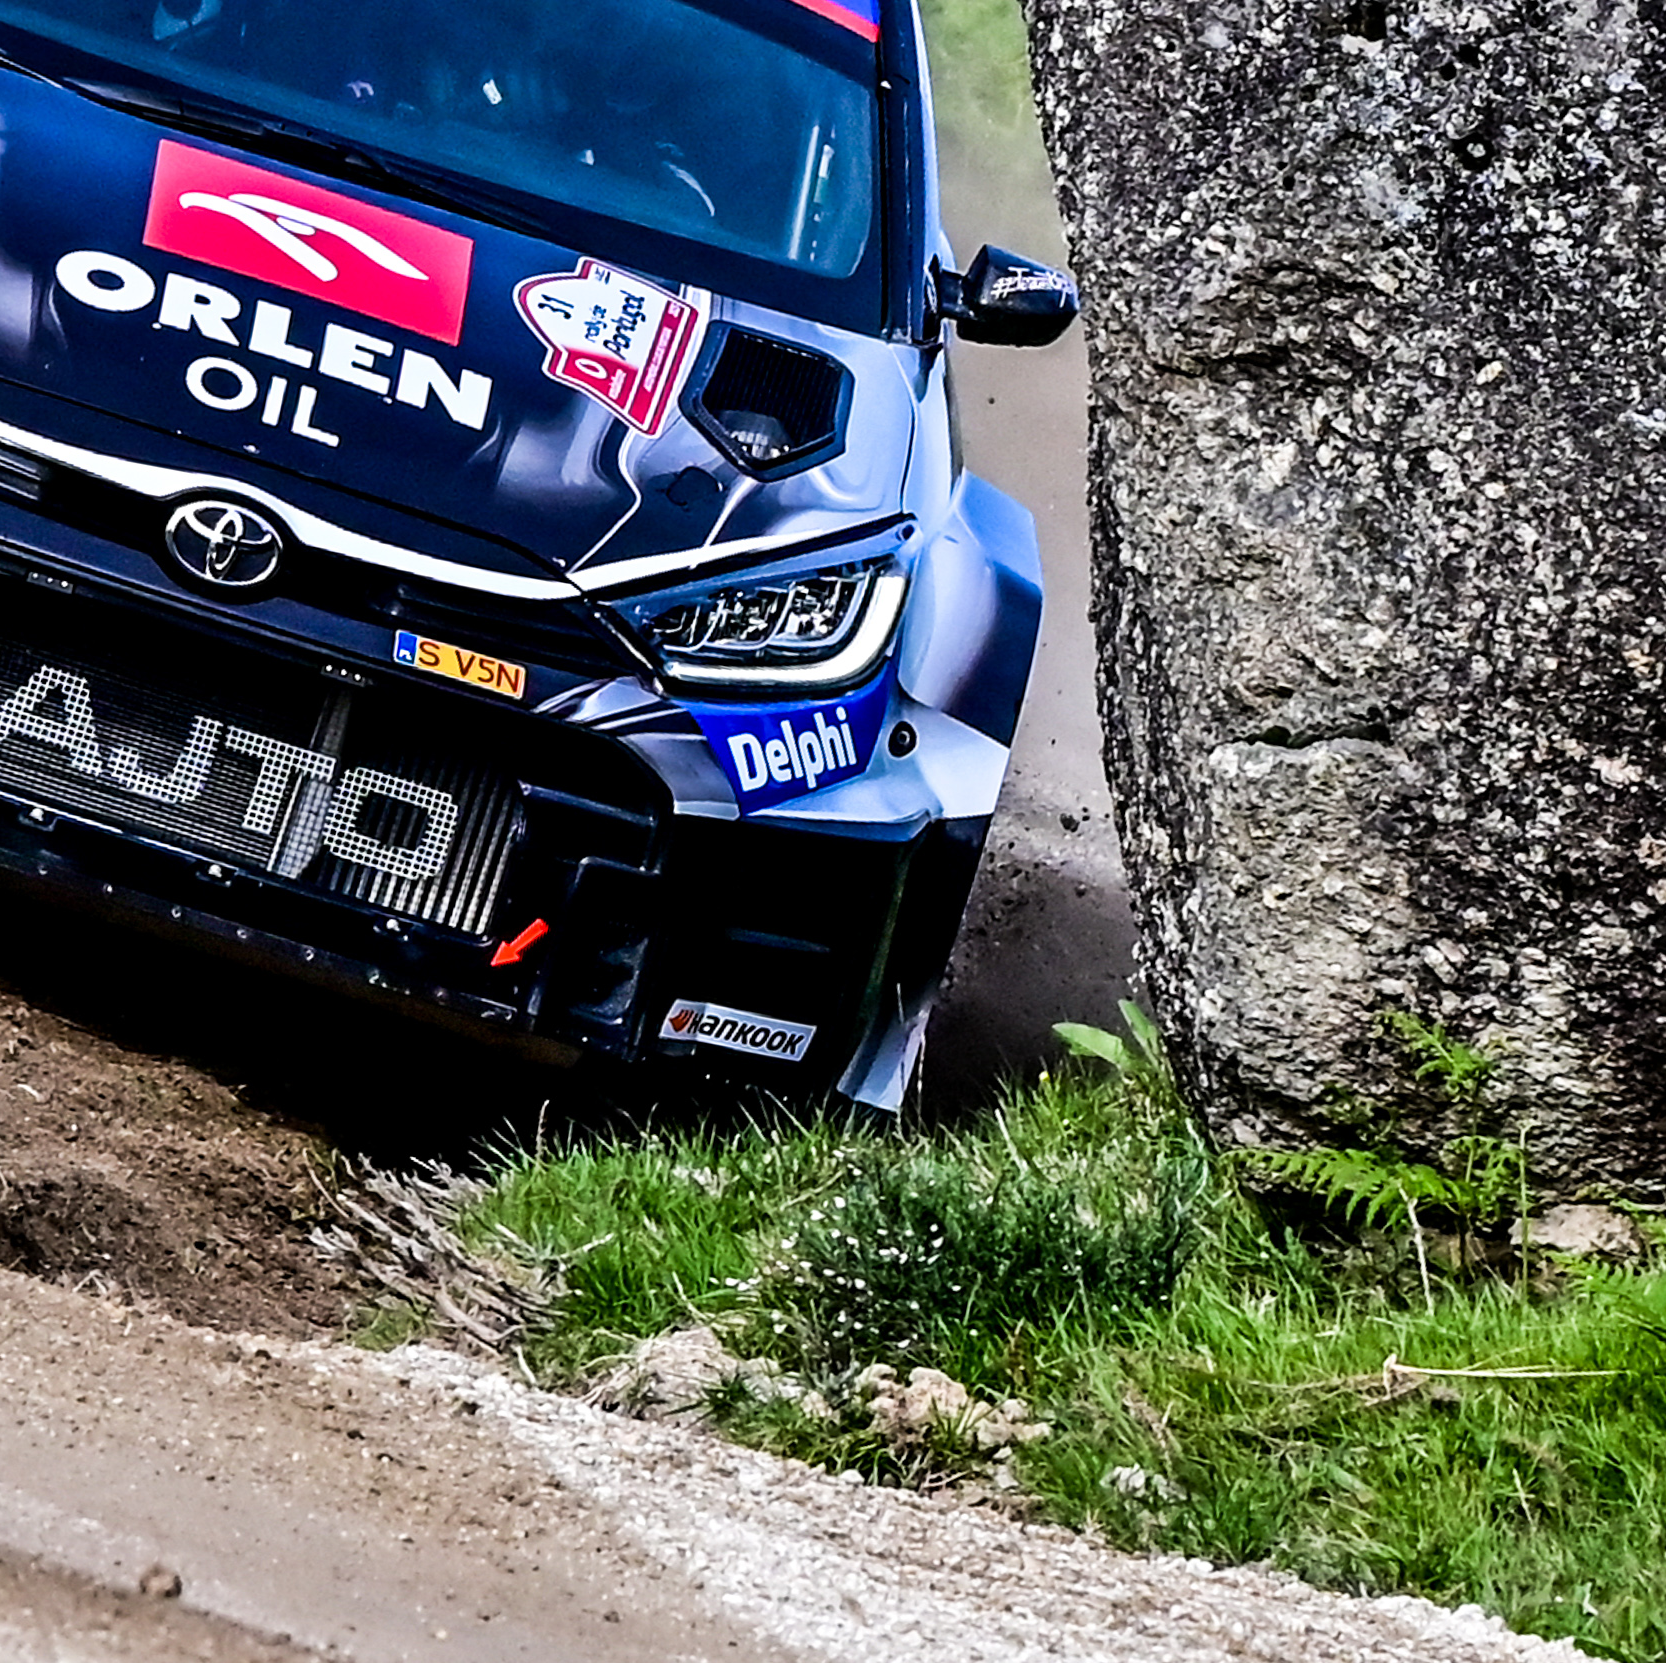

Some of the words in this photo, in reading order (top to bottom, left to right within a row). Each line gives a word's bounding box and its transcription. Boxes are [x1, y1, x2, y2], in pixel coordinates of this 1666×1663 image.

[55, 250, 493, 430] ORLEN
[602, 289, 647, 362] Portugal
[185, 356, 339, 447] OIL
[418, 641, 441, 667] S
[454, 649, 520, 693] V5N
[726, 705, 858, 792] Delphi
